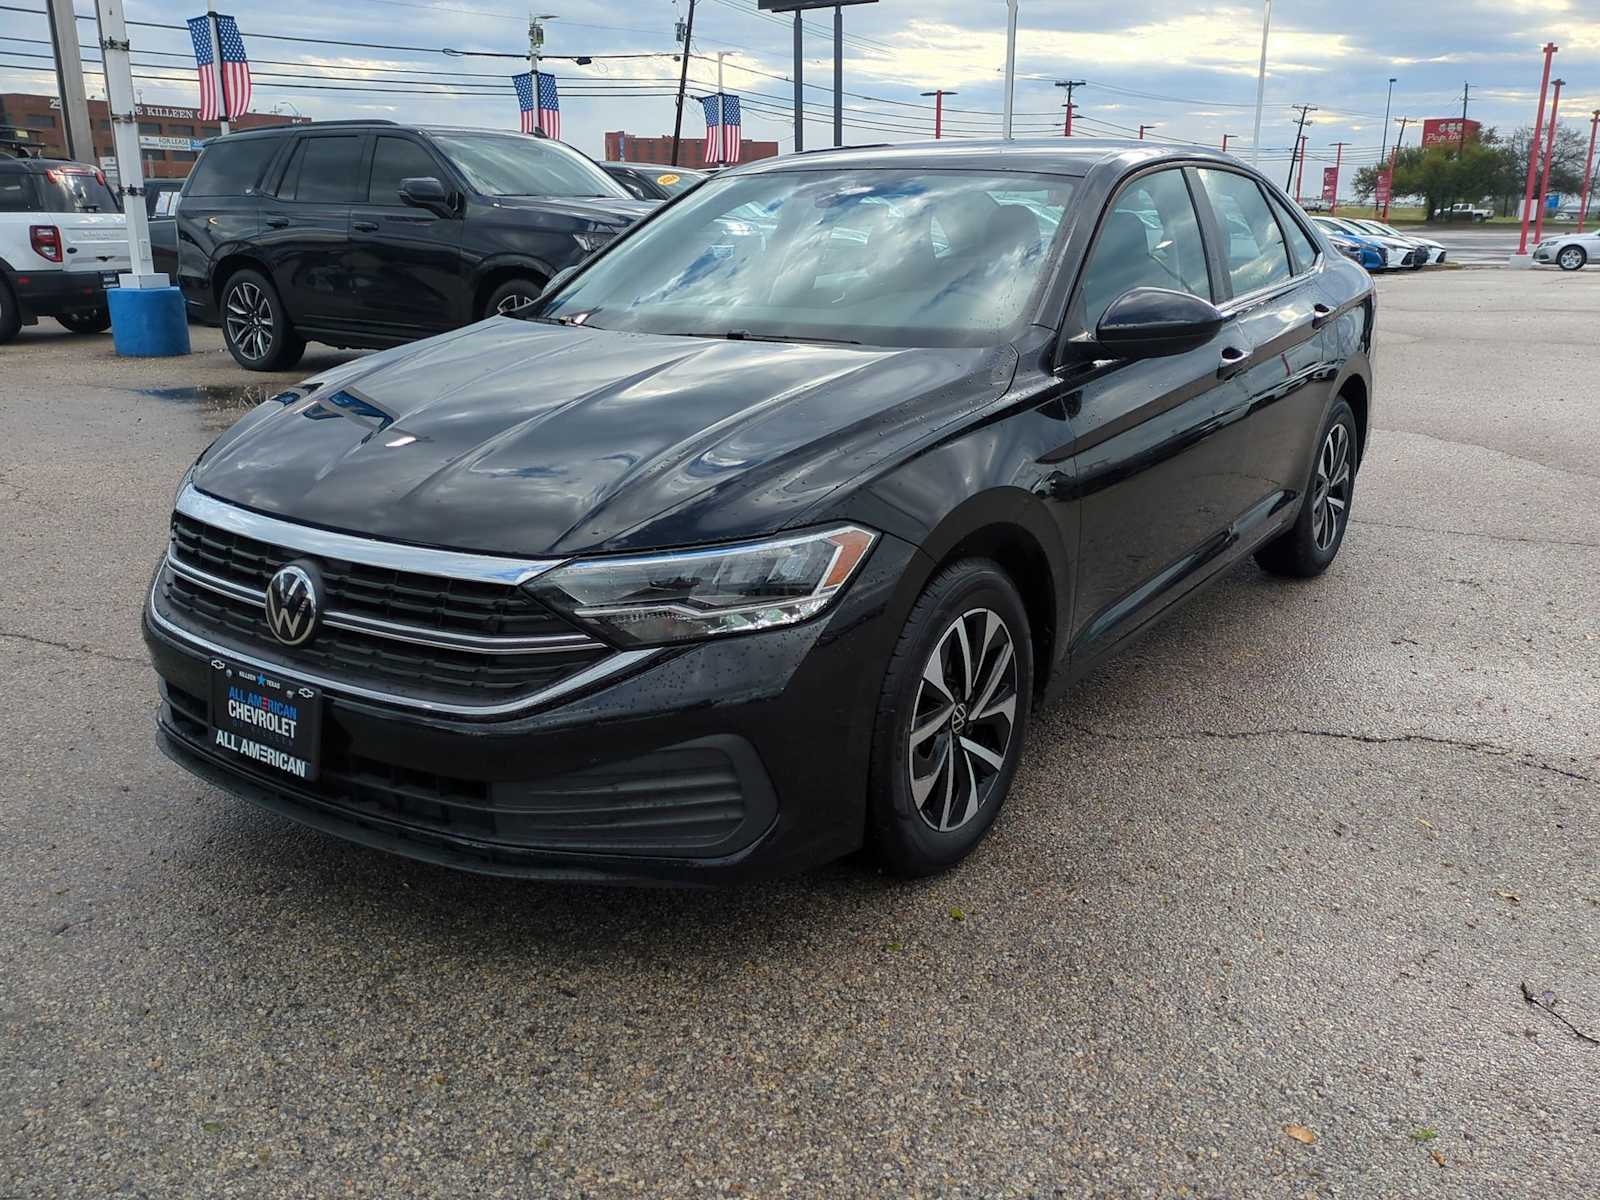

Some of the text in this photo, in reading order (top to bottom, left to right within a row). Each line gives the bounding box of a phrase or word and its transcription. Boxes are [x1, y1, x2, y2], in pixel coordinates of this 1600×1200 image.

[147, 107, 193, 119] KILLEEN
[266, 679, 281, 690] TEXAS
[228, 686, 297, 720] ALL AMERICAN
[228, 699, 297, 739] CHEVROLET
[215, 729, 239, 752] ALL
[240, 738, 306, 778] AMERICAN
